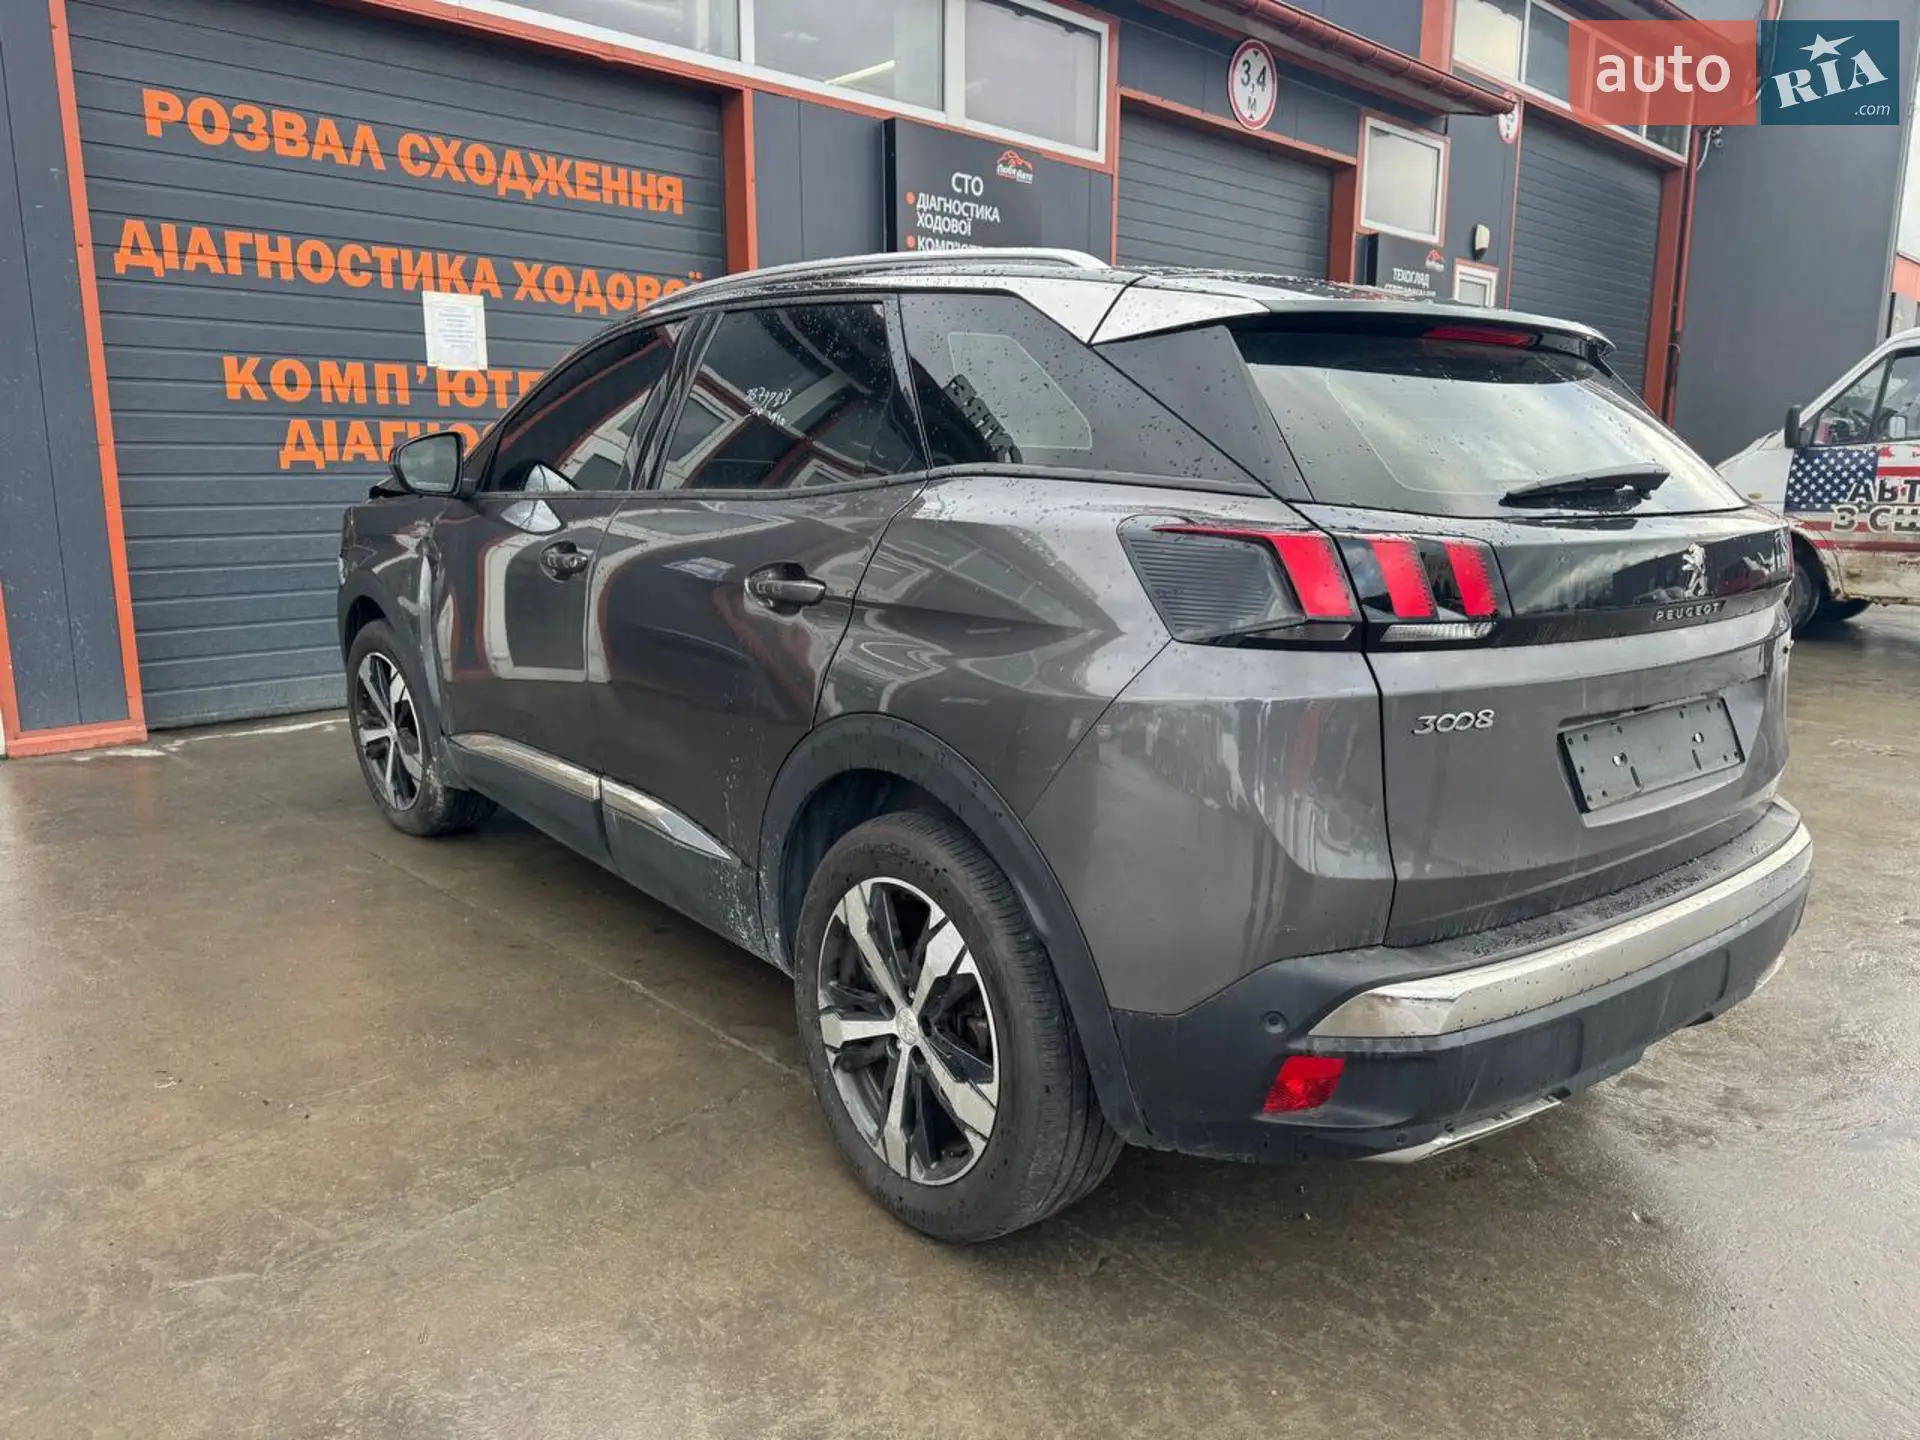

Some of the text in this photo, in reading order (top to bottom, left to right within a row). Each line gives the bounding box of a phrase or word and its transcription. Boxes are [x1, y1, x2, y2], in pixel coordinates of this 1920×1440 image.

[142, 88, 684, 215] РОЗВАЛ СХОДЖЕННЯ
[951, 171, 984, 197] СТО
[916, 192, 1001, 223] ДІАГНОСТИКА
[916, 210, 972, 237] ХОДОВОЇ
[114, 219, 703, 316] ДІАГНОСТИКА ХОДОВ
[1655, 602, 1721, 622] PEUGEOT
[1412, 707, 1495, 736] 3008
